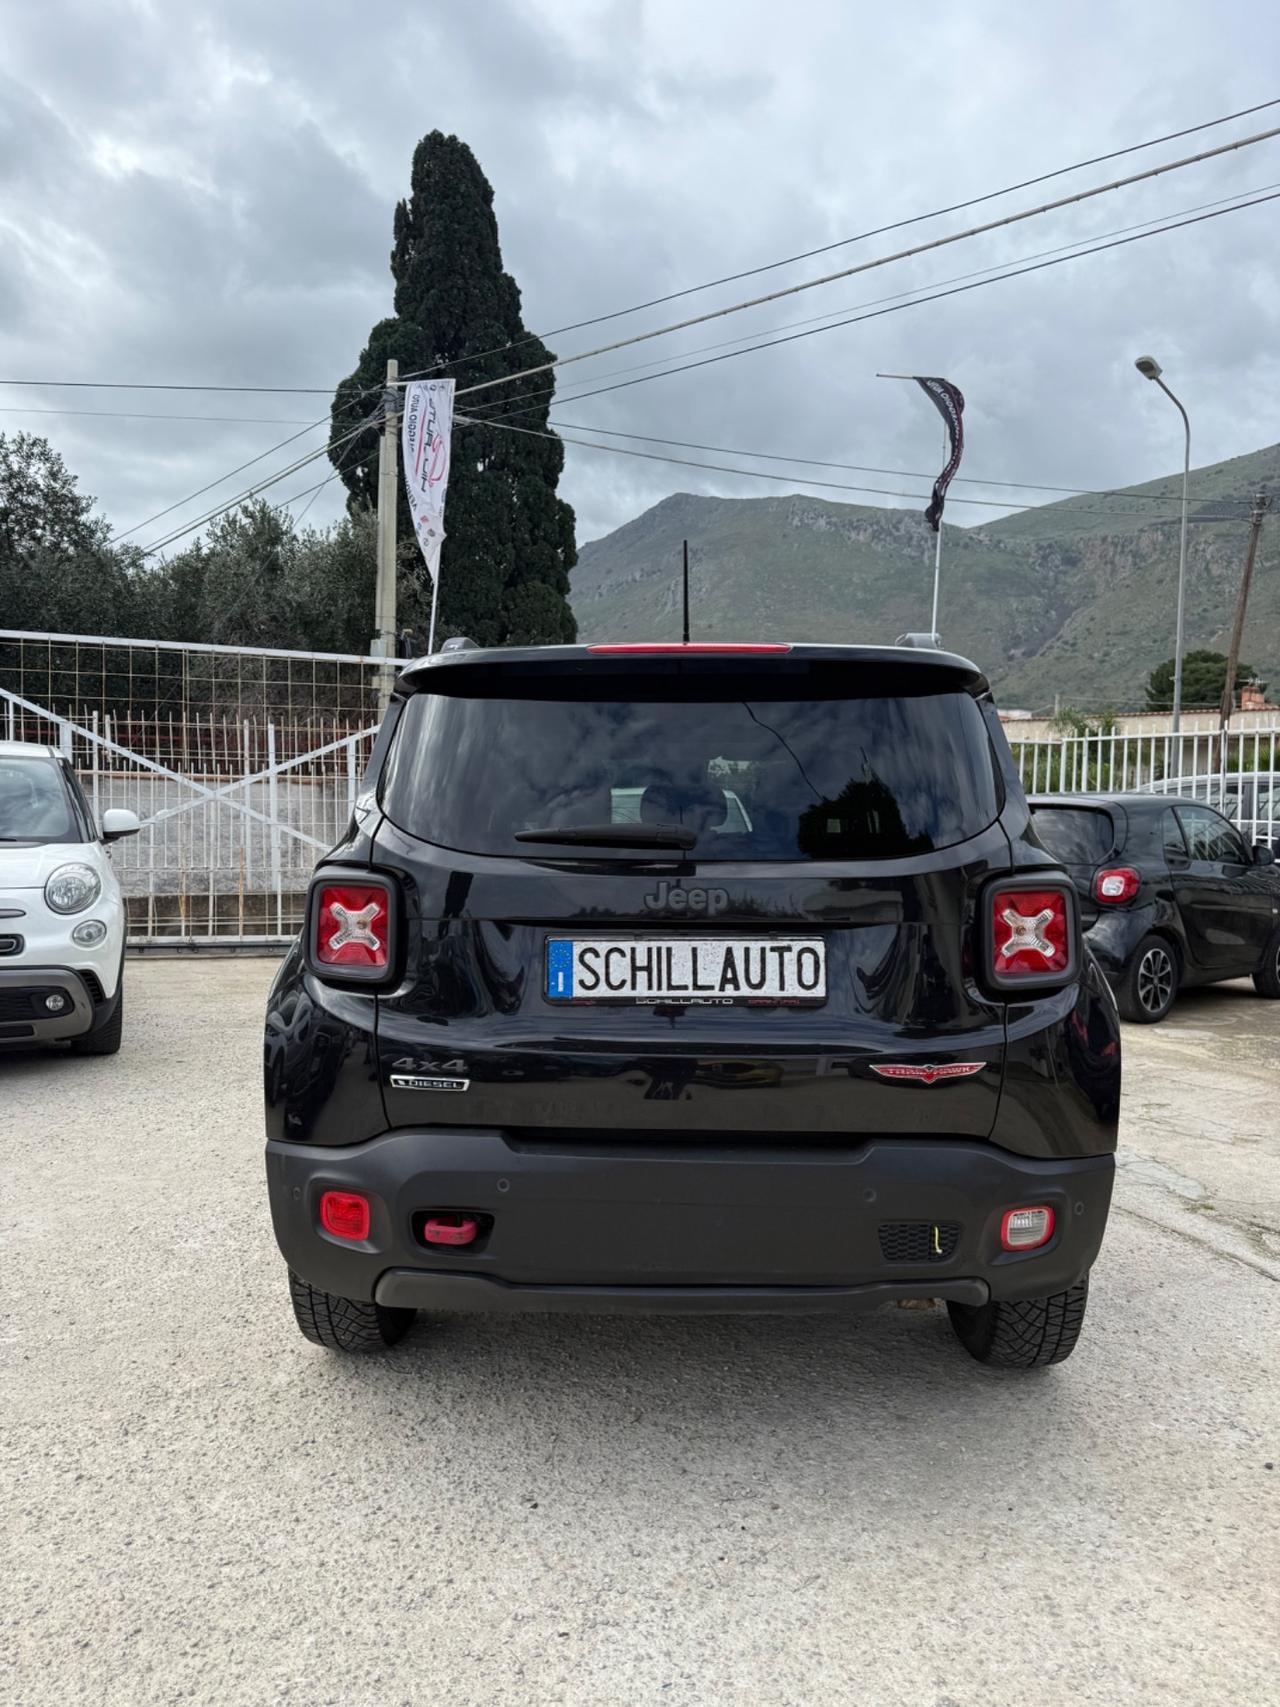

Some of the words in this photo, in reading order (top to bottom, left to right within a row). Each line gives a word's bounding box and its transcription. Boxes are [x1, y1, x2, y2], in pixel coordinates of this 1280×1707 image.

[644, 881, 729, 915] Jeep
[578, 946, 821, 991] SCHILLAUTO
[408, 1079, 462, 1088] DIESEL
